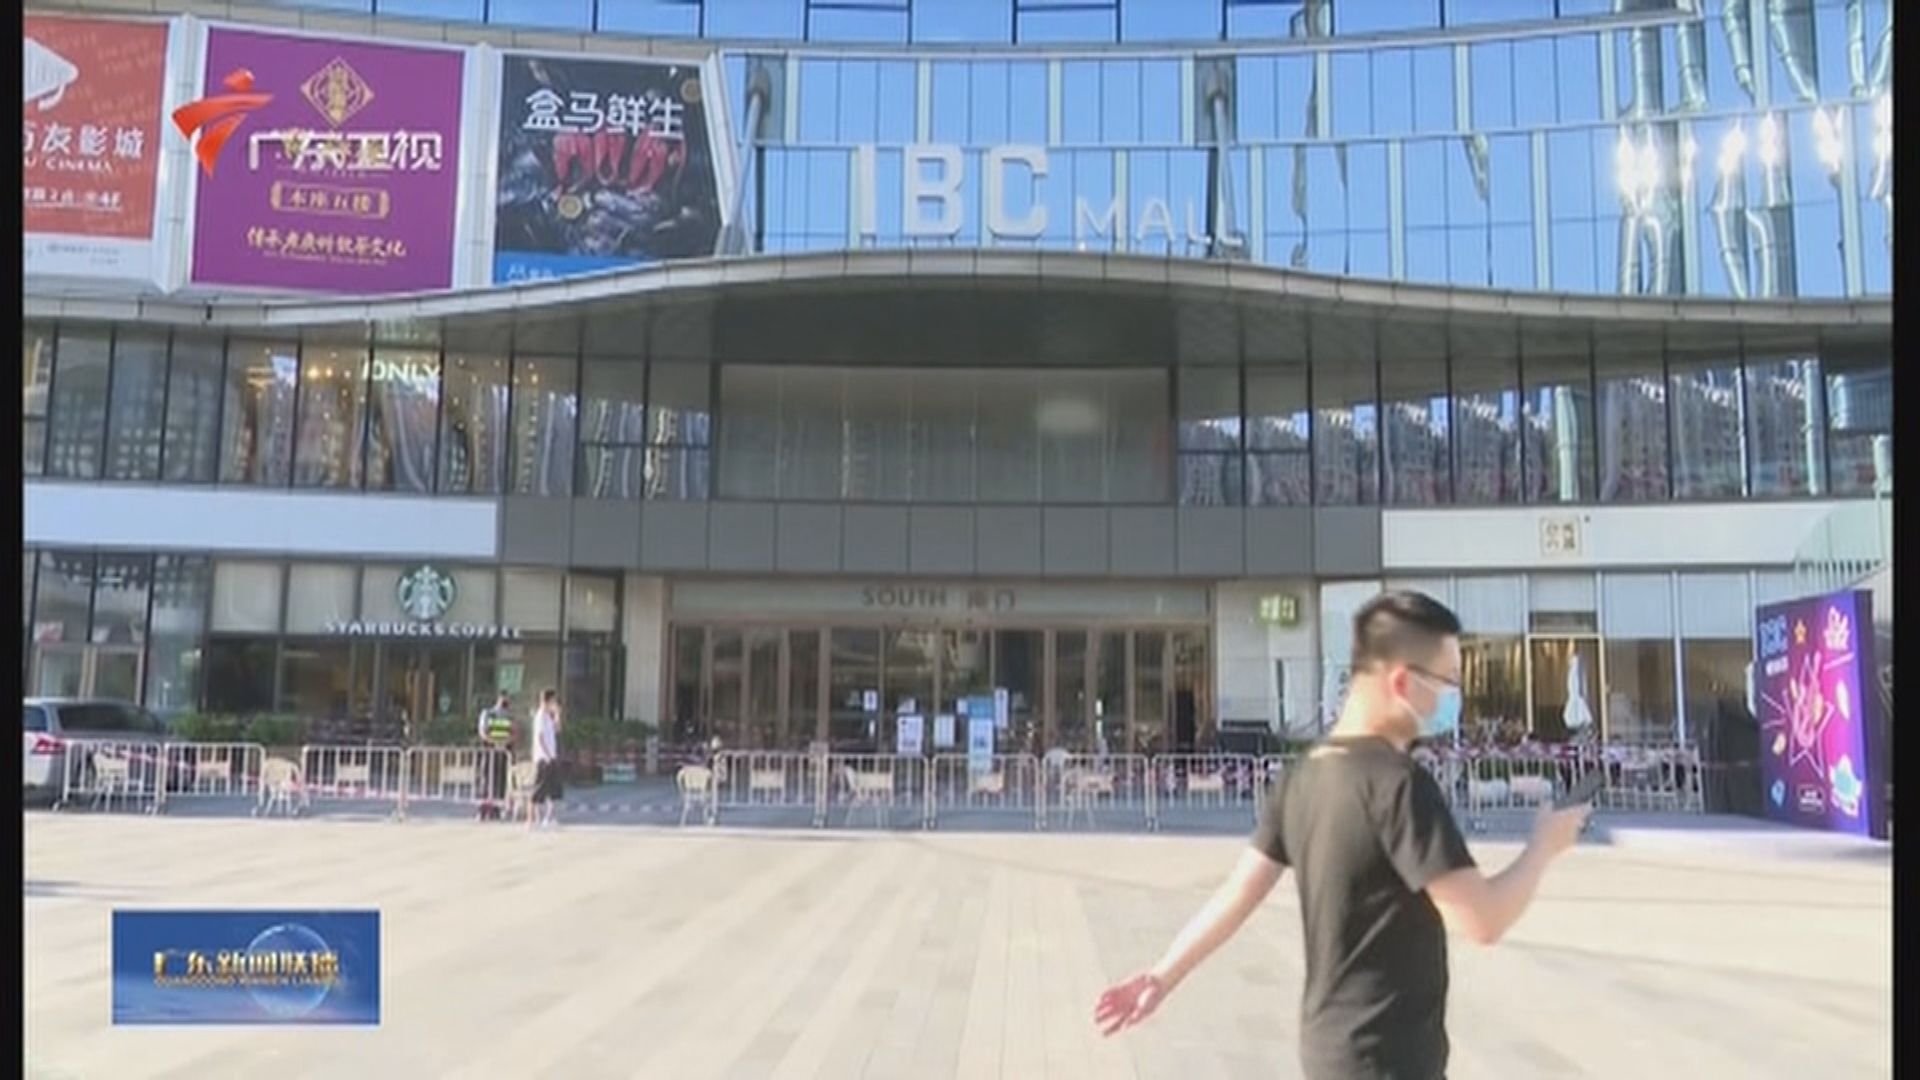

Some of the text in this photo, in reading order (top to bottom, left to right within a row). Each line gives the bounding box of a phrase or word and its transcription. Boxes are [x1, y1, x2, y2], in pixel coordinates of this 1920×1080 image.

[523, 88, 684, 139] 盒马鲜生
[45, 158, 112, 174] CINEMA
[859, 144, 1246, 246] IBC MALL
[362, 361, 441, 384] ONLY
[862, 586, 947, 606] SOUTH
[325, 620, 522, 639] STARBUCKS COFFEE
